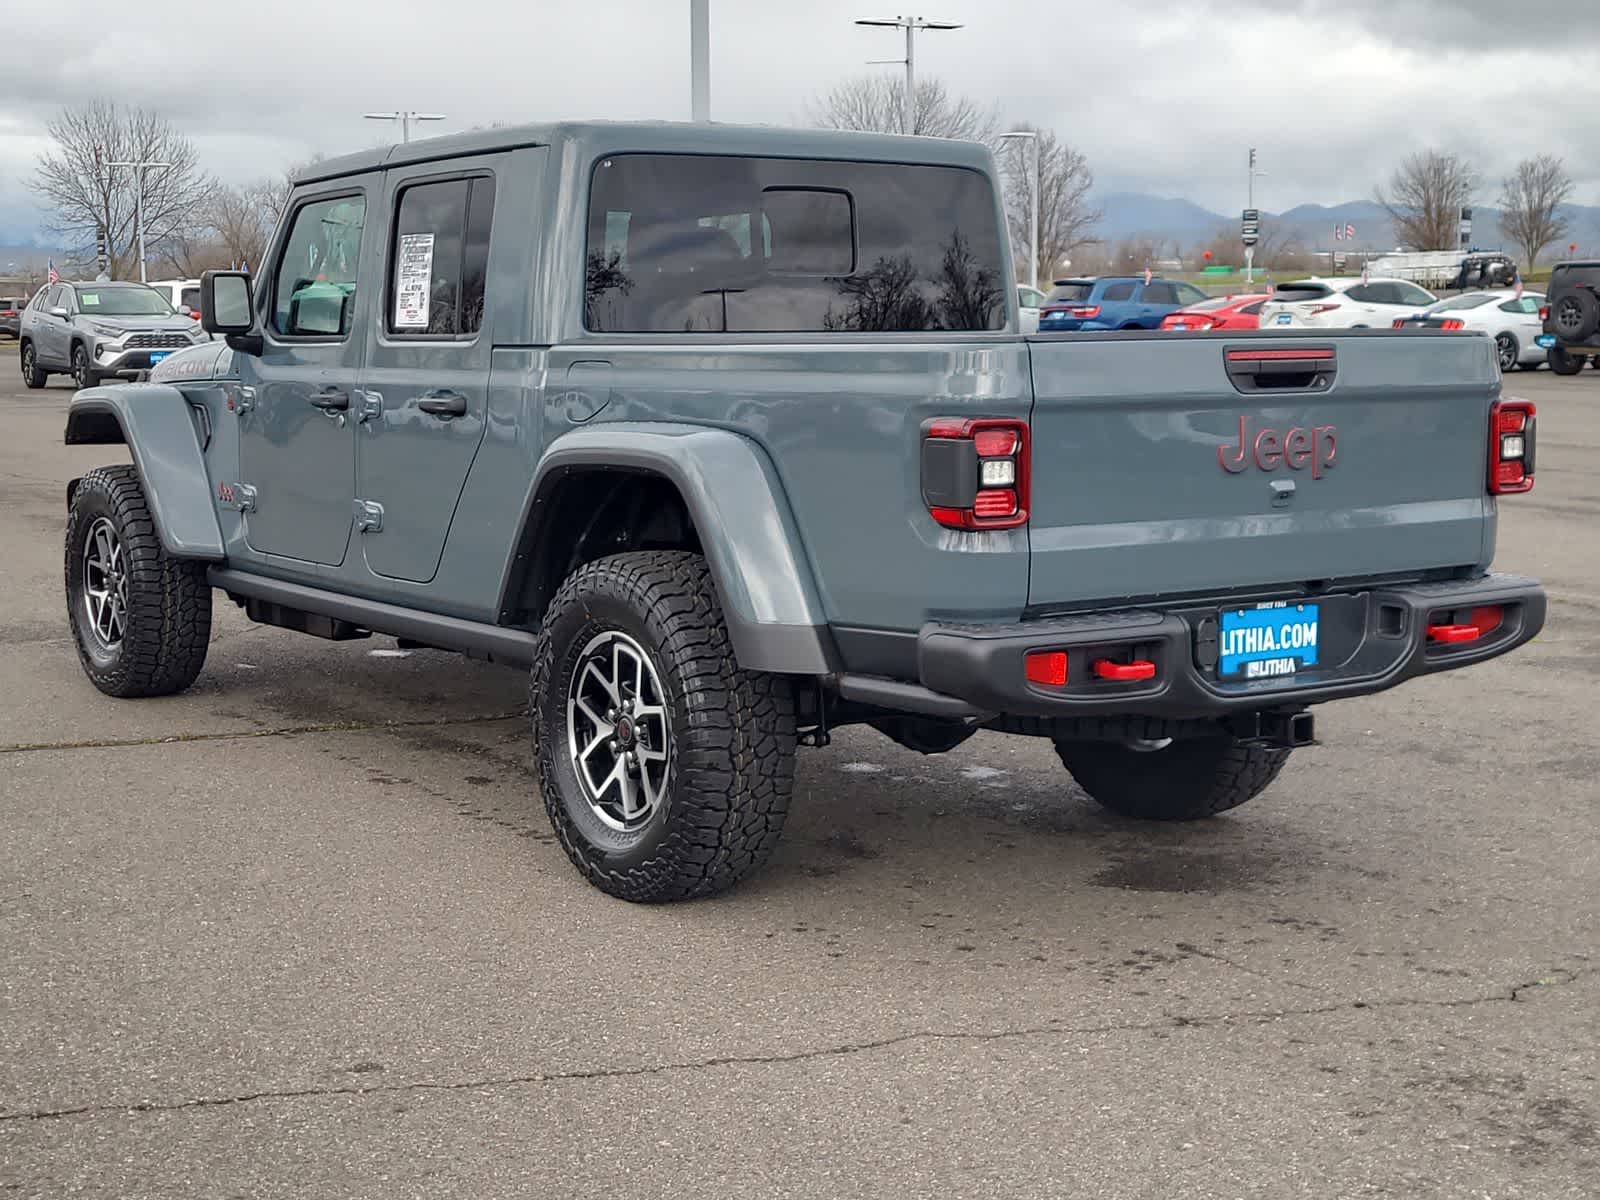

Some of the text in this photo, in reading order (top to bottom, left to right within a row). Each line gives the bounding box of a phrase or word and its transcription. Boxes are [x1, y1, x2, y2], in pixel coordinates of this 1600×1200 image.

[1217, 415, 1336, 480] Jeep
[1221, 622, 1317, 656] LITHIA.COM
[1260, 657, 1296, 676] LITHIA
